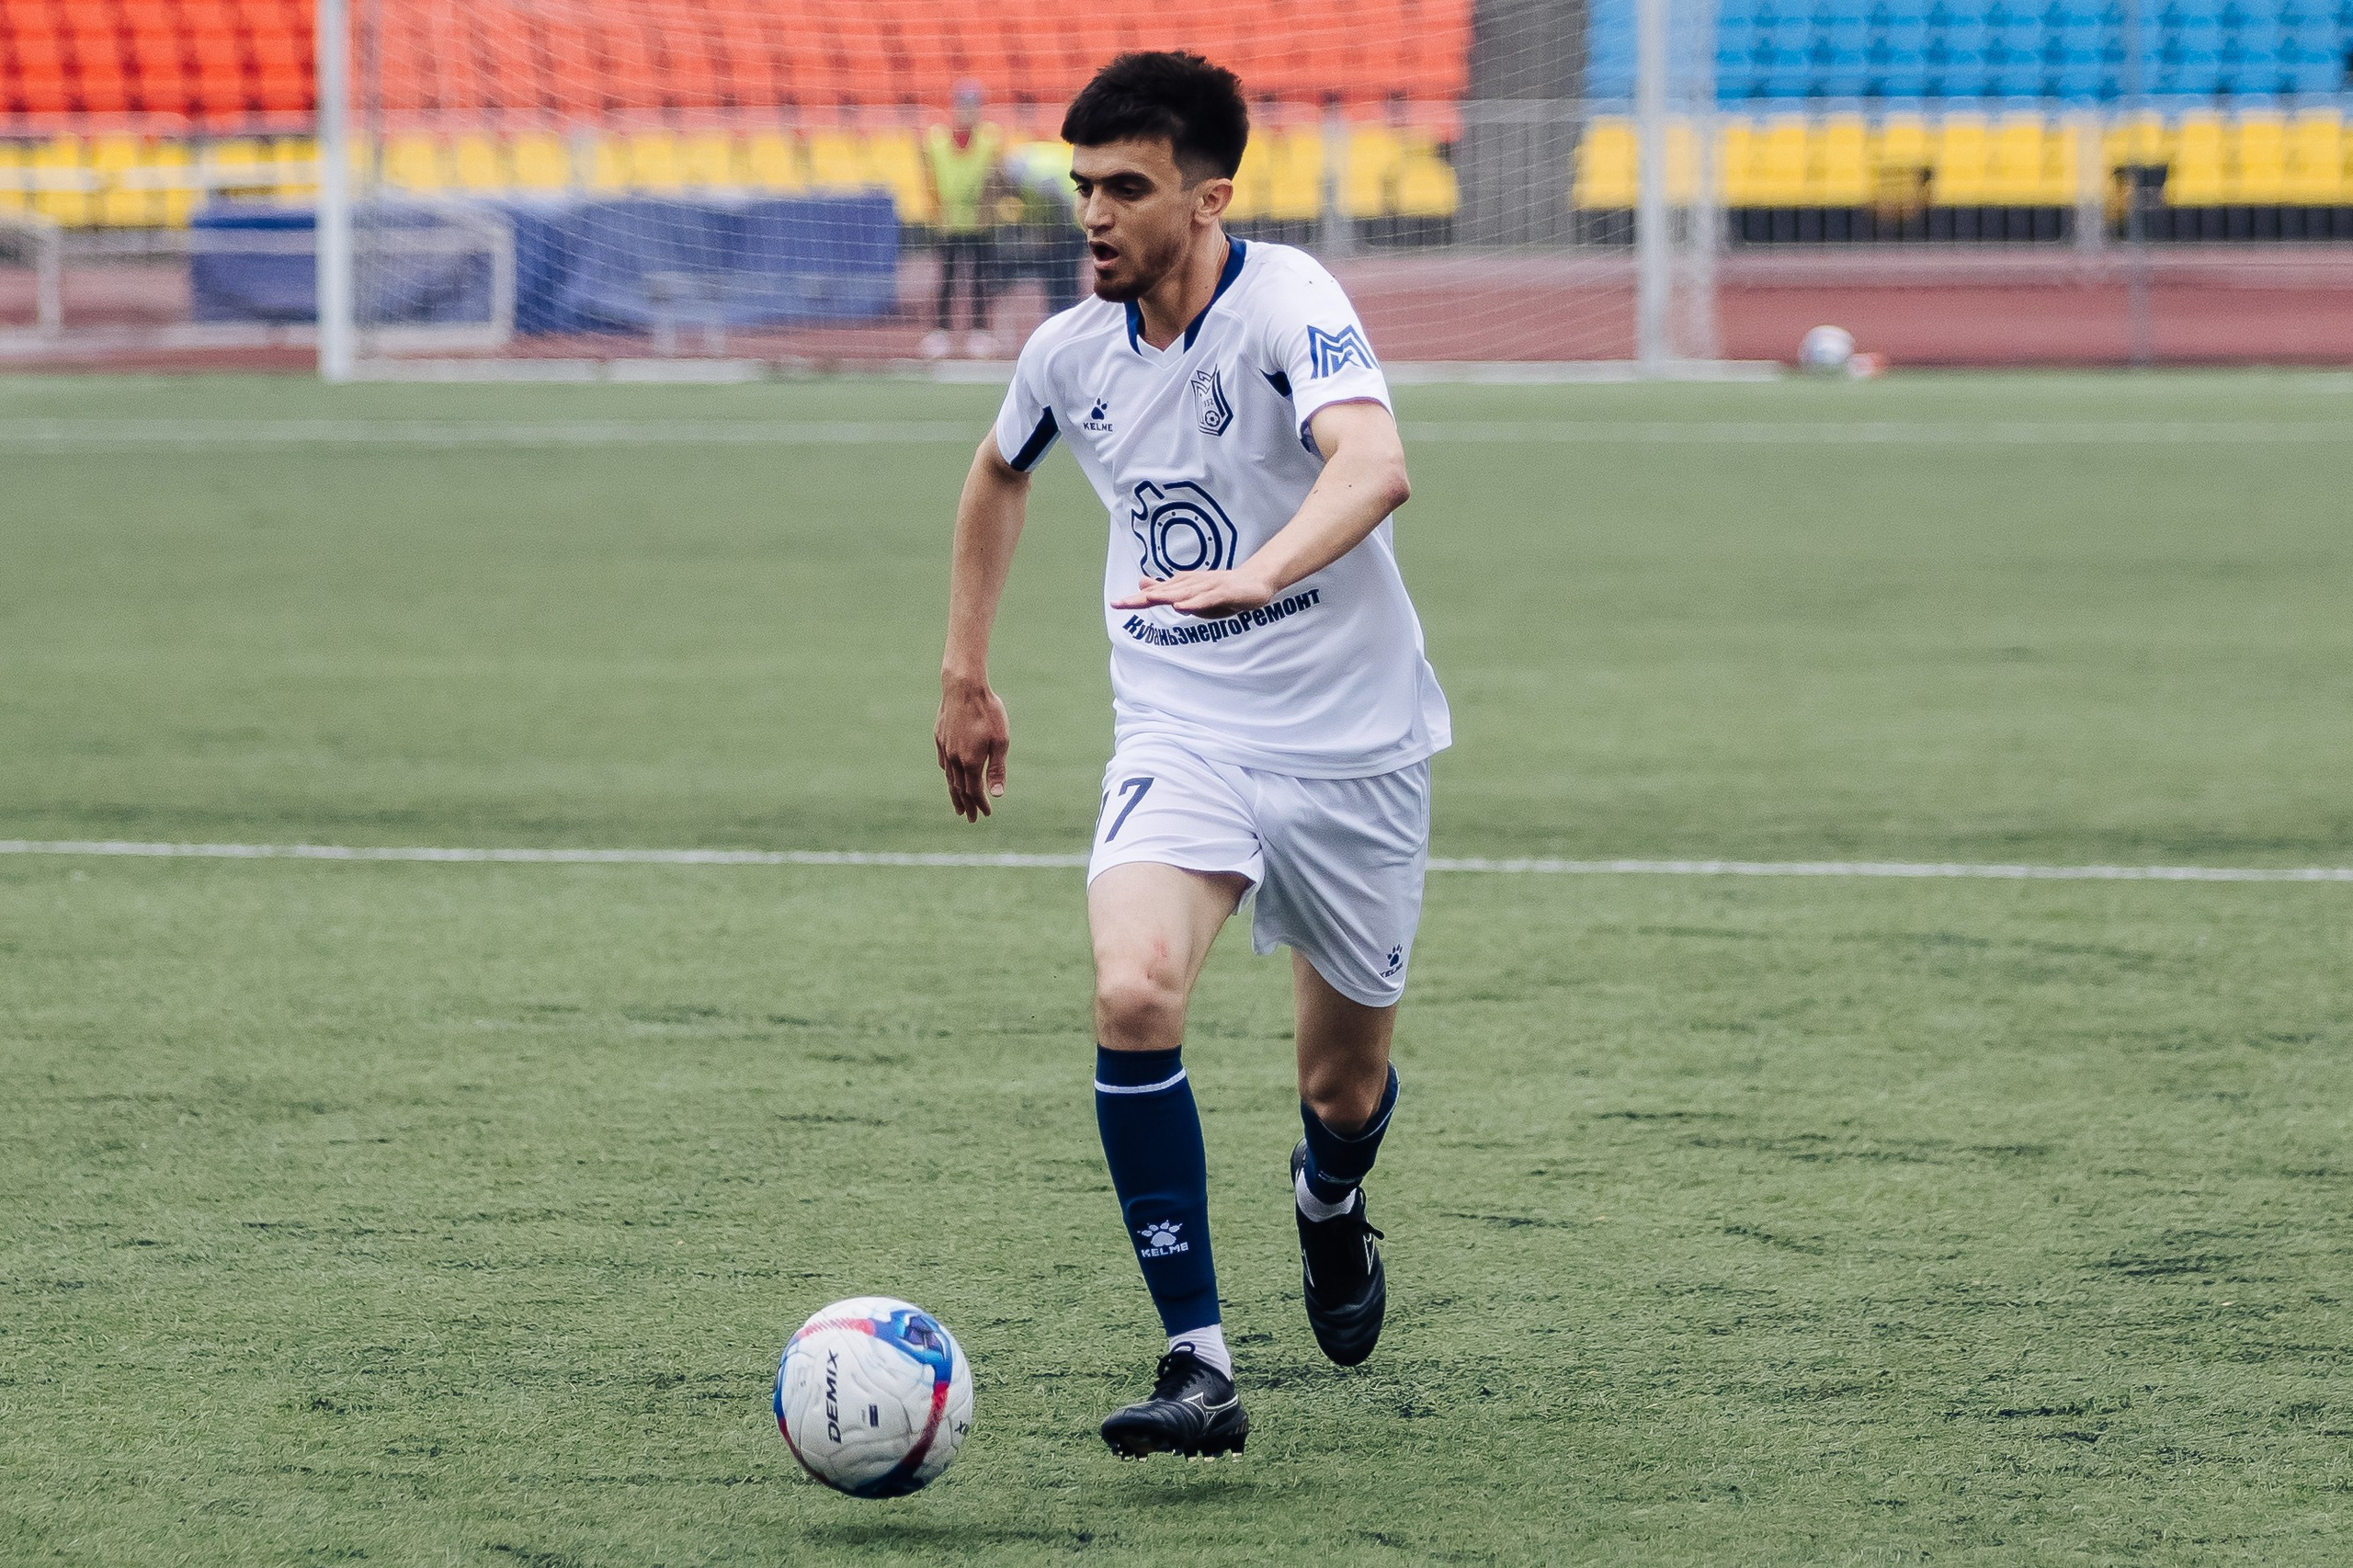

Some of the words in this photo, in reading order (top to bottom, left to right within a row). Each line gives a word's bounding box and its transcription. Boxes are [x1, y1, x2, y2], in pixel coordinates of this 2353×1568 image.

[1083, 422, 1113, 432] KELME
[1141, 1242, 1189, 1257] KELME
[825, 1347, 842, 1444] DEMIX
